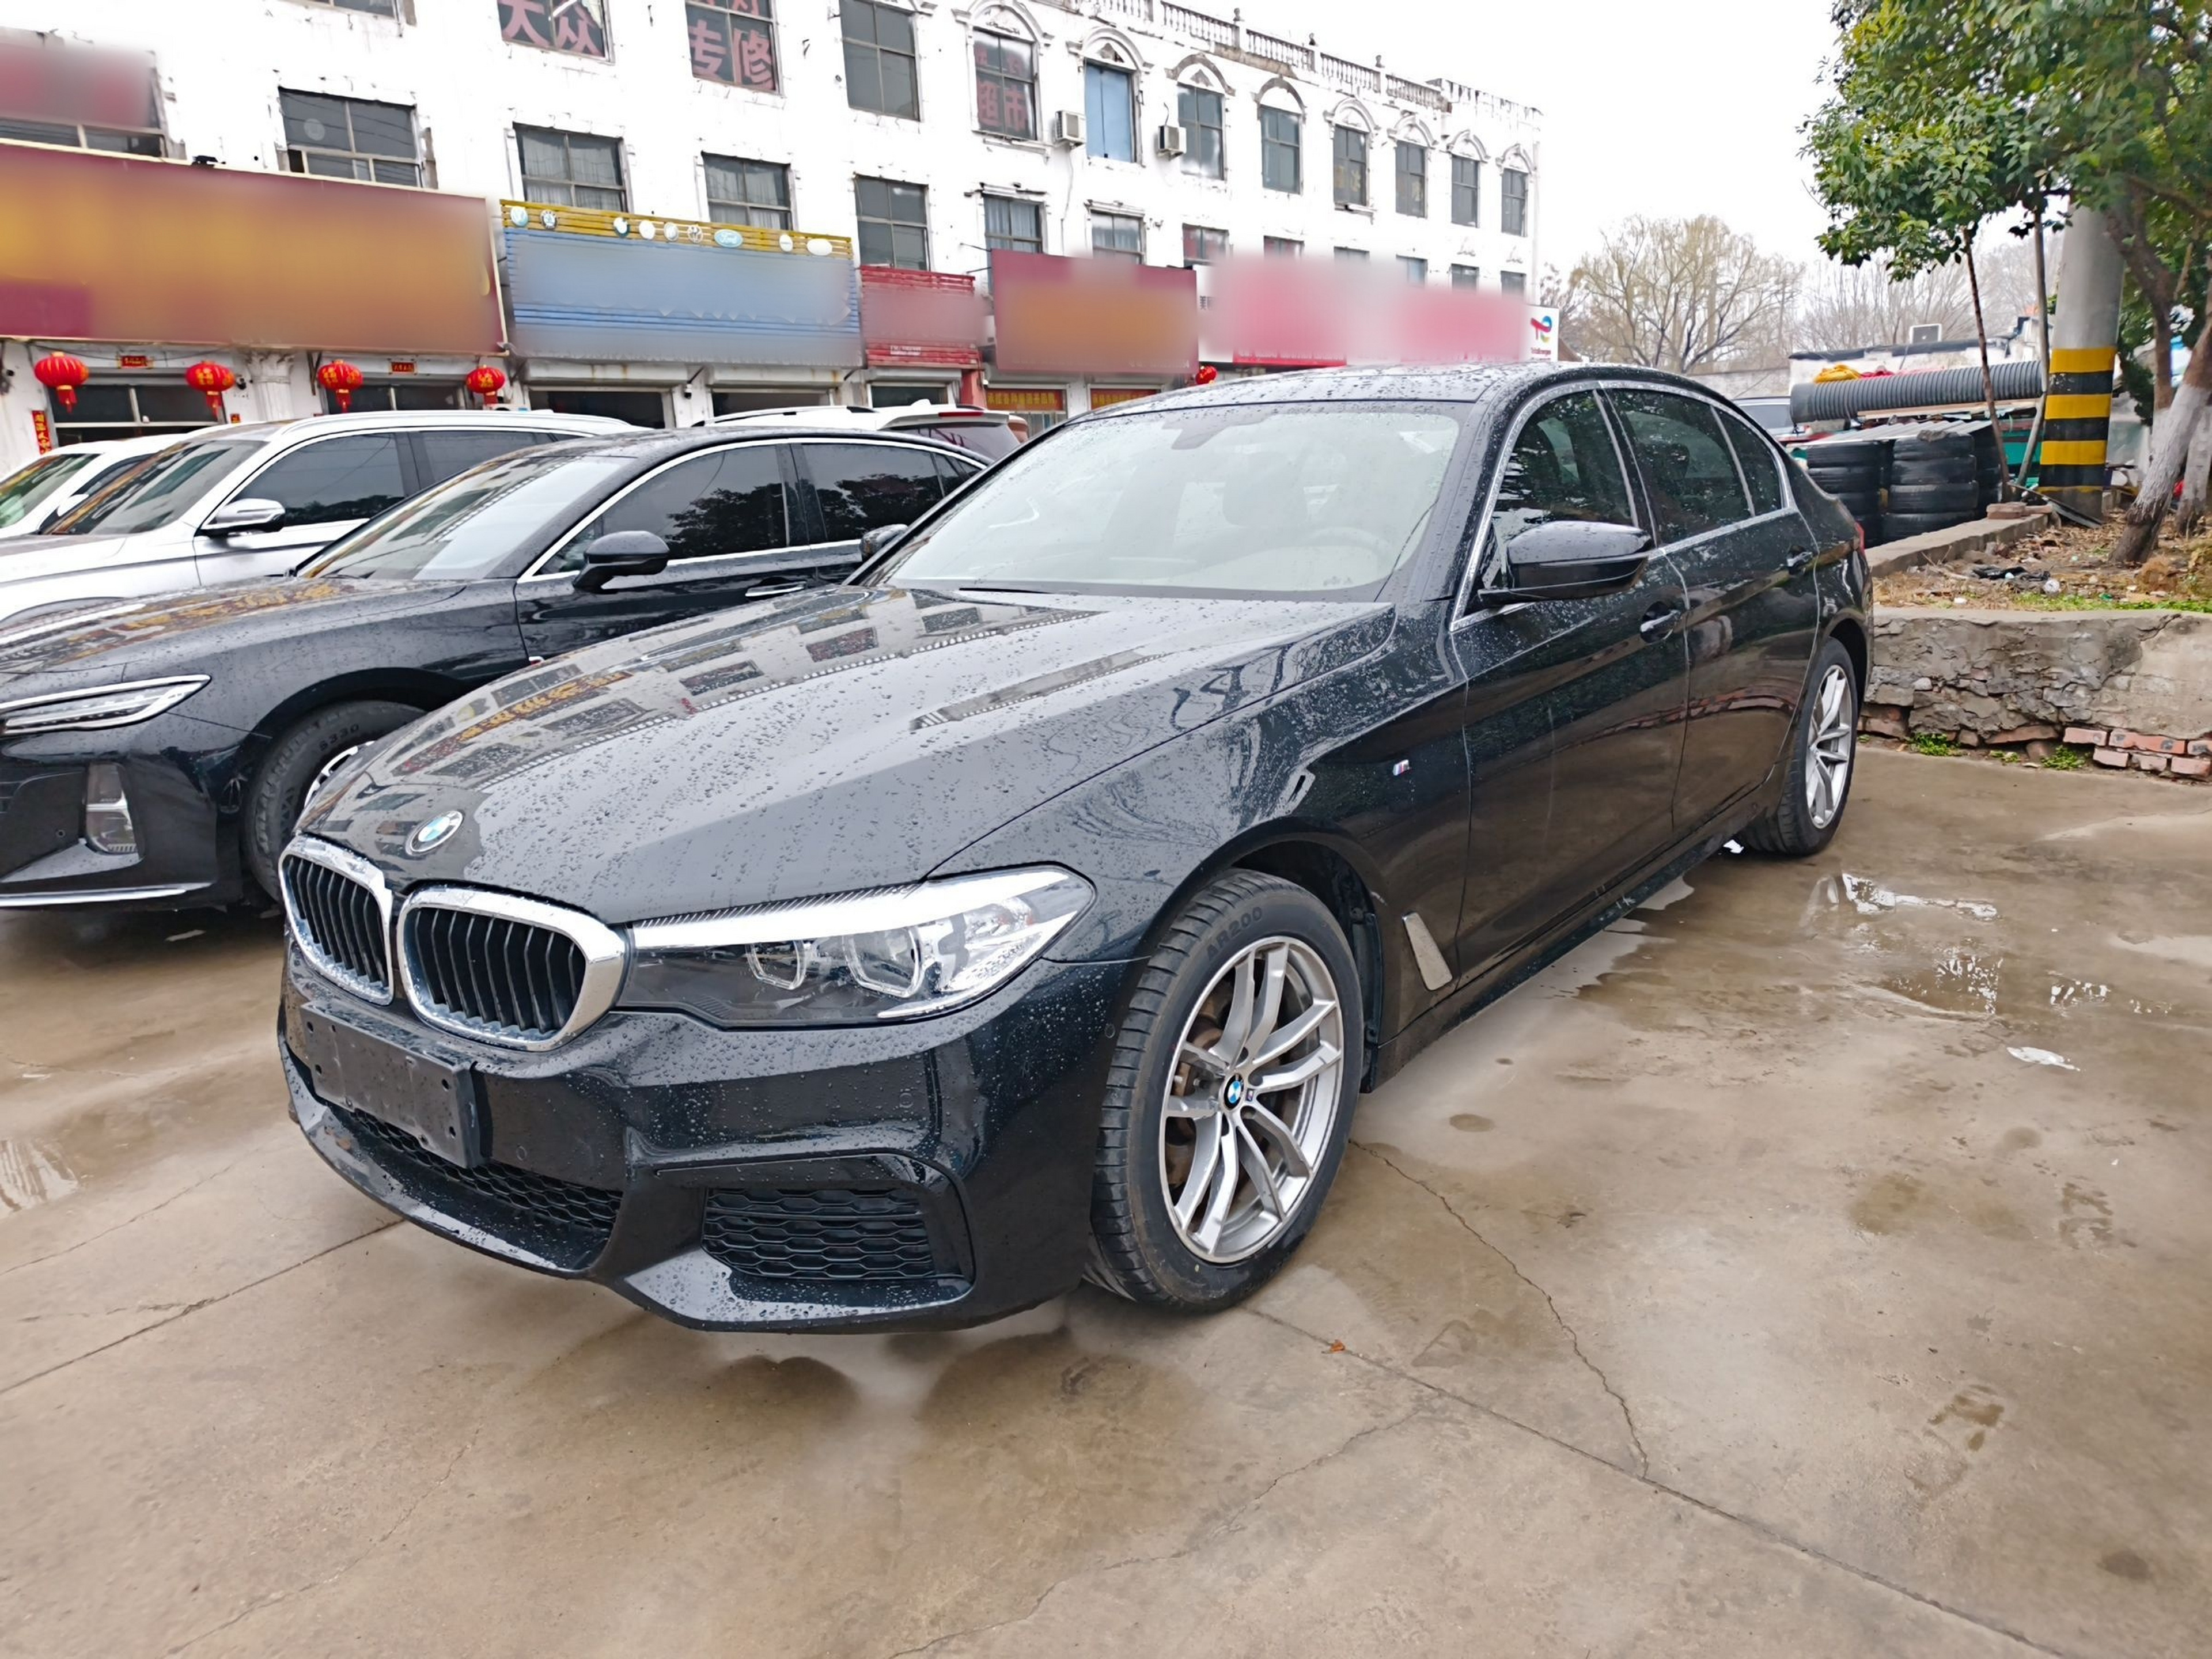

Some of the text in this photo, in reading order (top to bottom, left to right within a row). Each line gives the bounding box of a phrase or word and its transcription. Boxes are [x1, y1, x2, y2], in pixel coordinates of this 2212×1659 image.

[498, 0, 604, 56] 大众
[688, 19, 774, 89] 专修
[1207, 906, 1263, 961] AR200
